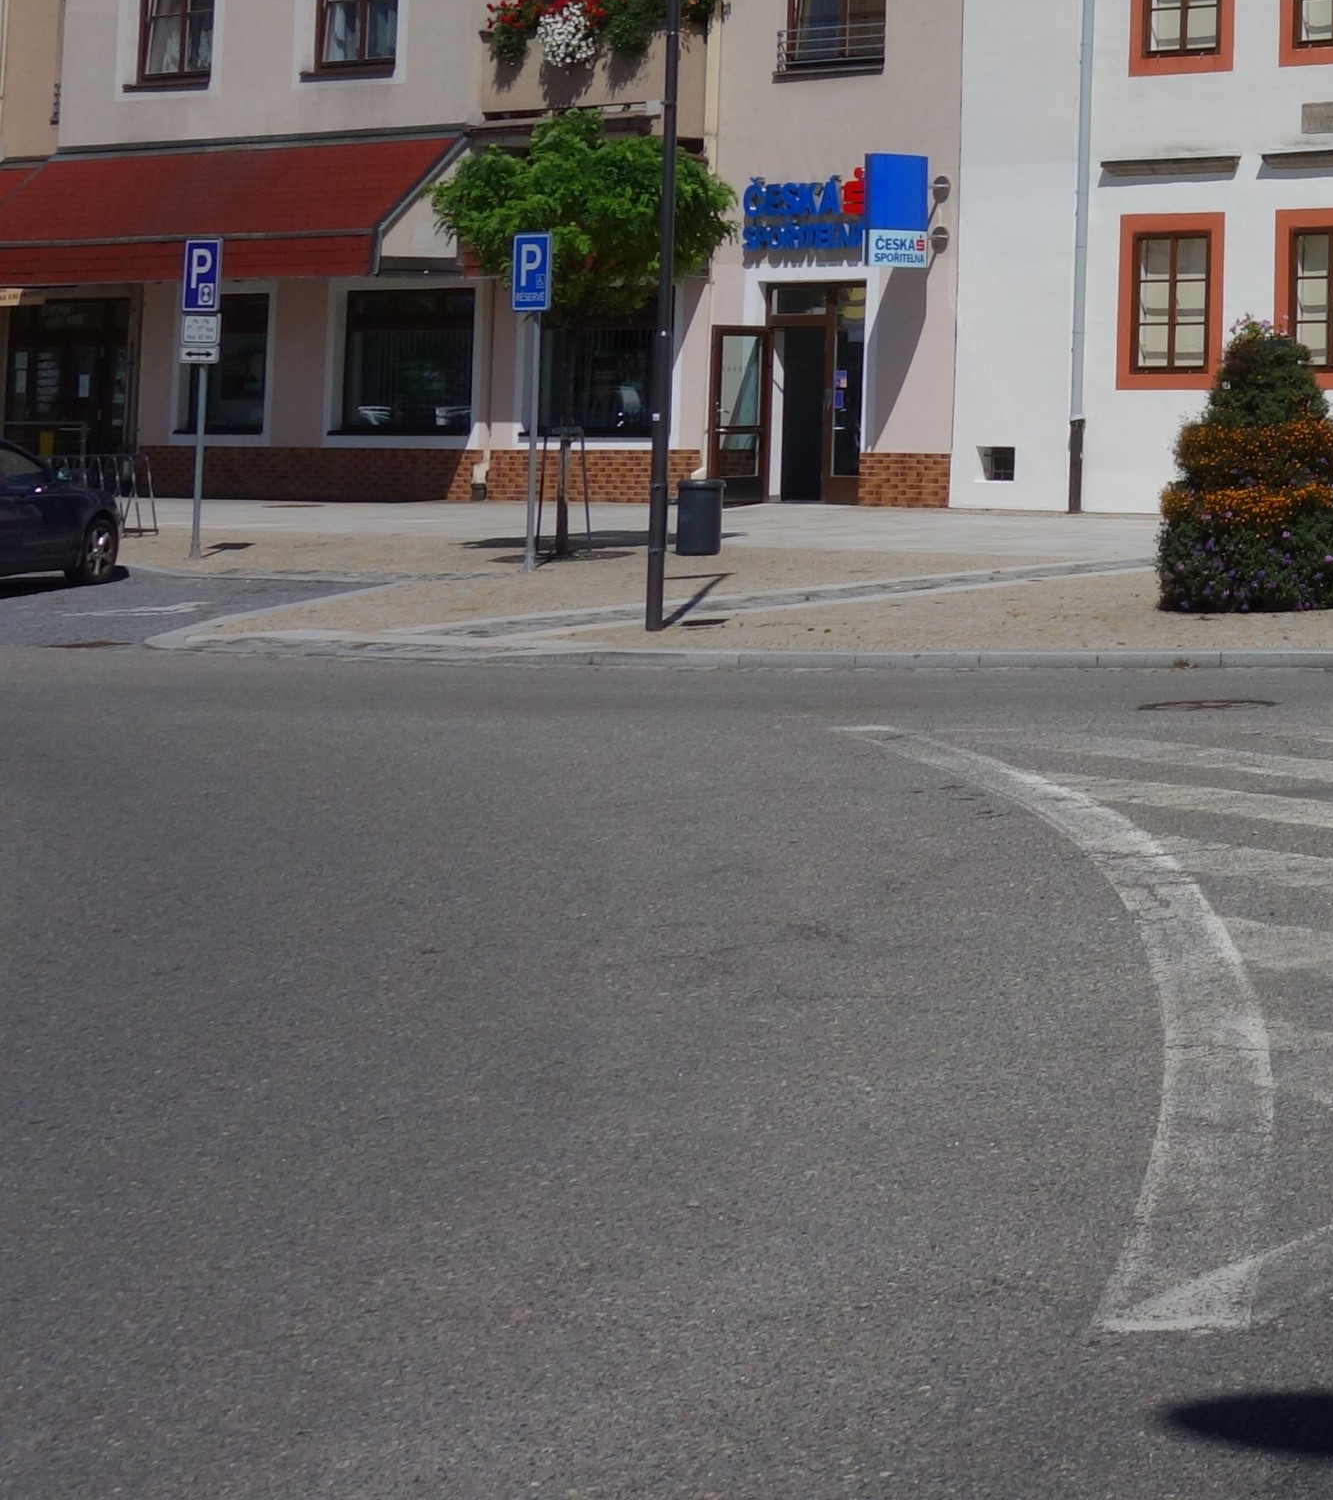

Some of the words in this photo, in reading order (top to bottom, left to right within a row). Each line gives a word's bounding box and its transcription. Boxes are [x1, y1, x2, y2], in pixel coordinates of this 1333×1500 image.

[743, 176, 841, 216] ČESKÁ
[742, 220, 864, 251] SPOŘITELN
[875, 235, 915, 251] ČESKÁ
[190, 248, 213, 289] P
[521, 243, 542, 287] P
[874, 251, 925, 263] SPOŘITELNA
